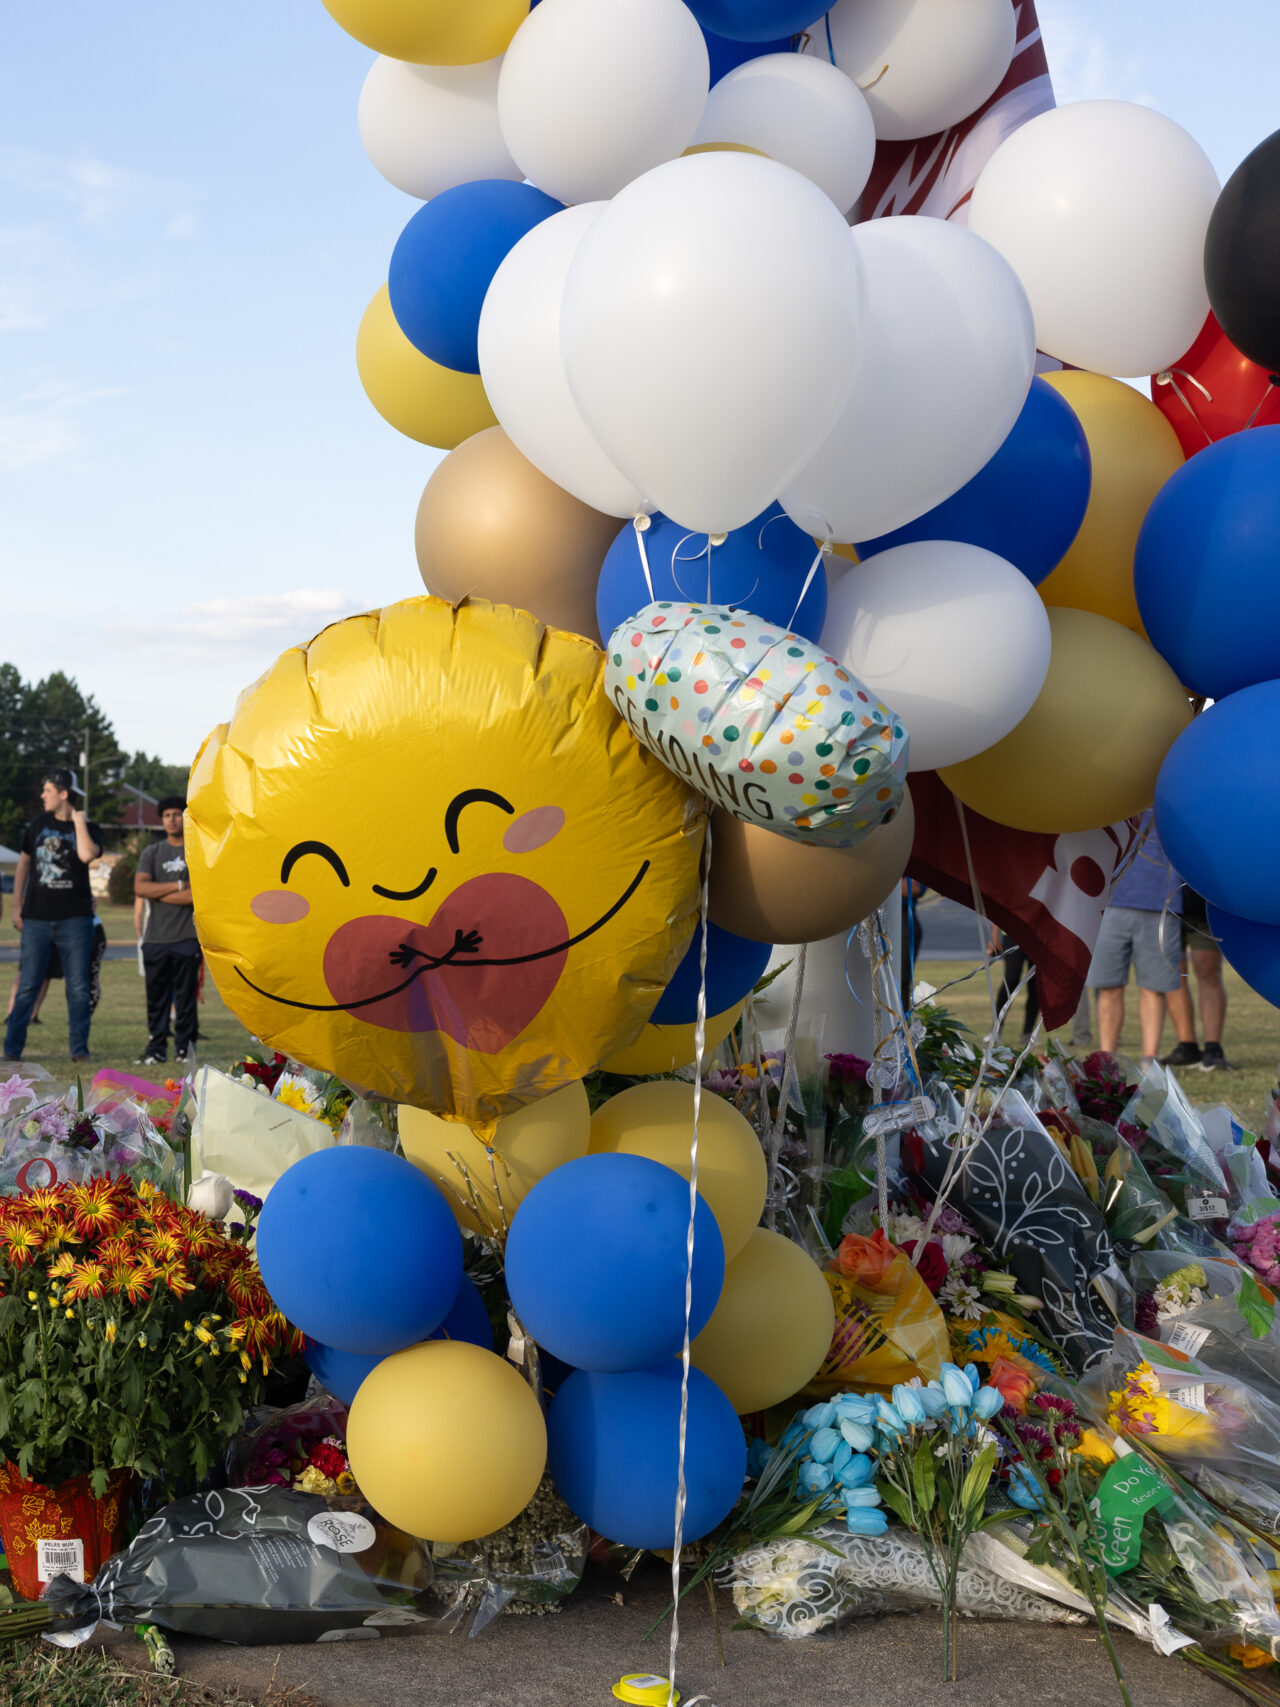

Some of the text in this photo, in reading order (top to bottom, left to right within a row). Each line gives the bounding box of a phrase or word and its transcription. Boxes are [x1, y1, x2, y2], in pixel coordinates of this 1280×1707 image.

[1112, 1476, 1140, 1495] Do
[1131, 1465, 1157, 1477] Yo
[320, 1519, 354, 1547] ROSE
